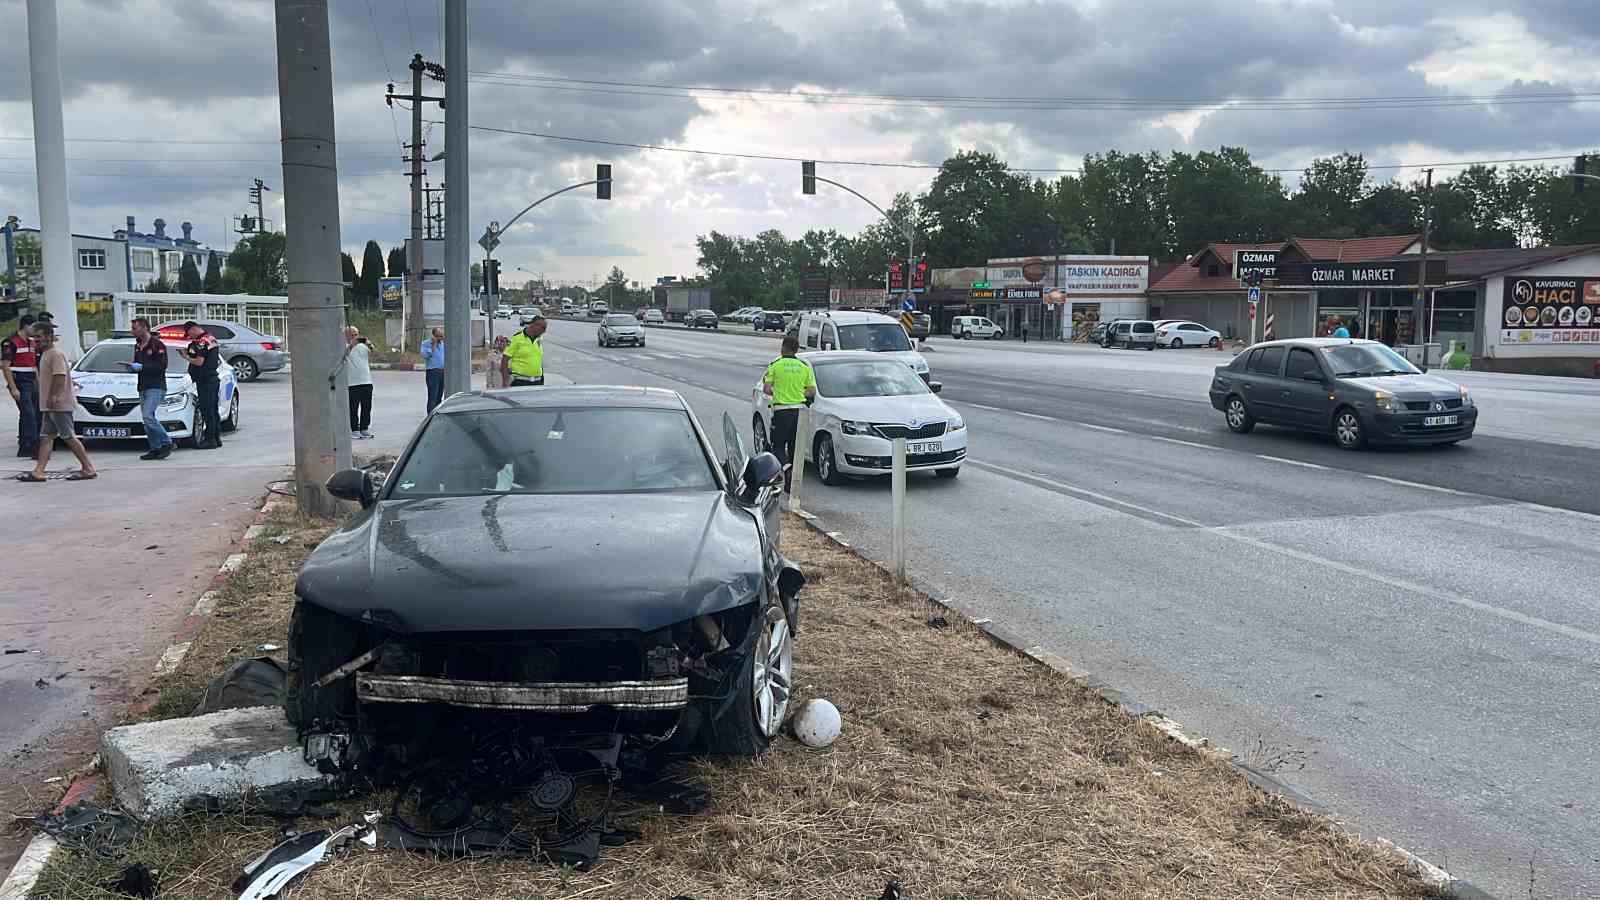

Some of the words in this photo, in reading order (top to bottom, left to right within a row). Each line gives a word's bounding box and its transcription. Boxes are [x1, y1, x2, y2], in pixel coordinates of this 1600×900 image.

[1242, 252, 1275, 262] ÖZMAR
[1312, 267, 1344, 281] ÖZMAR
[1352, 268, 1395, 281] MARKET
[1535, 290, 1575, 304] HACI
[87, 429, 96, 437] 41
